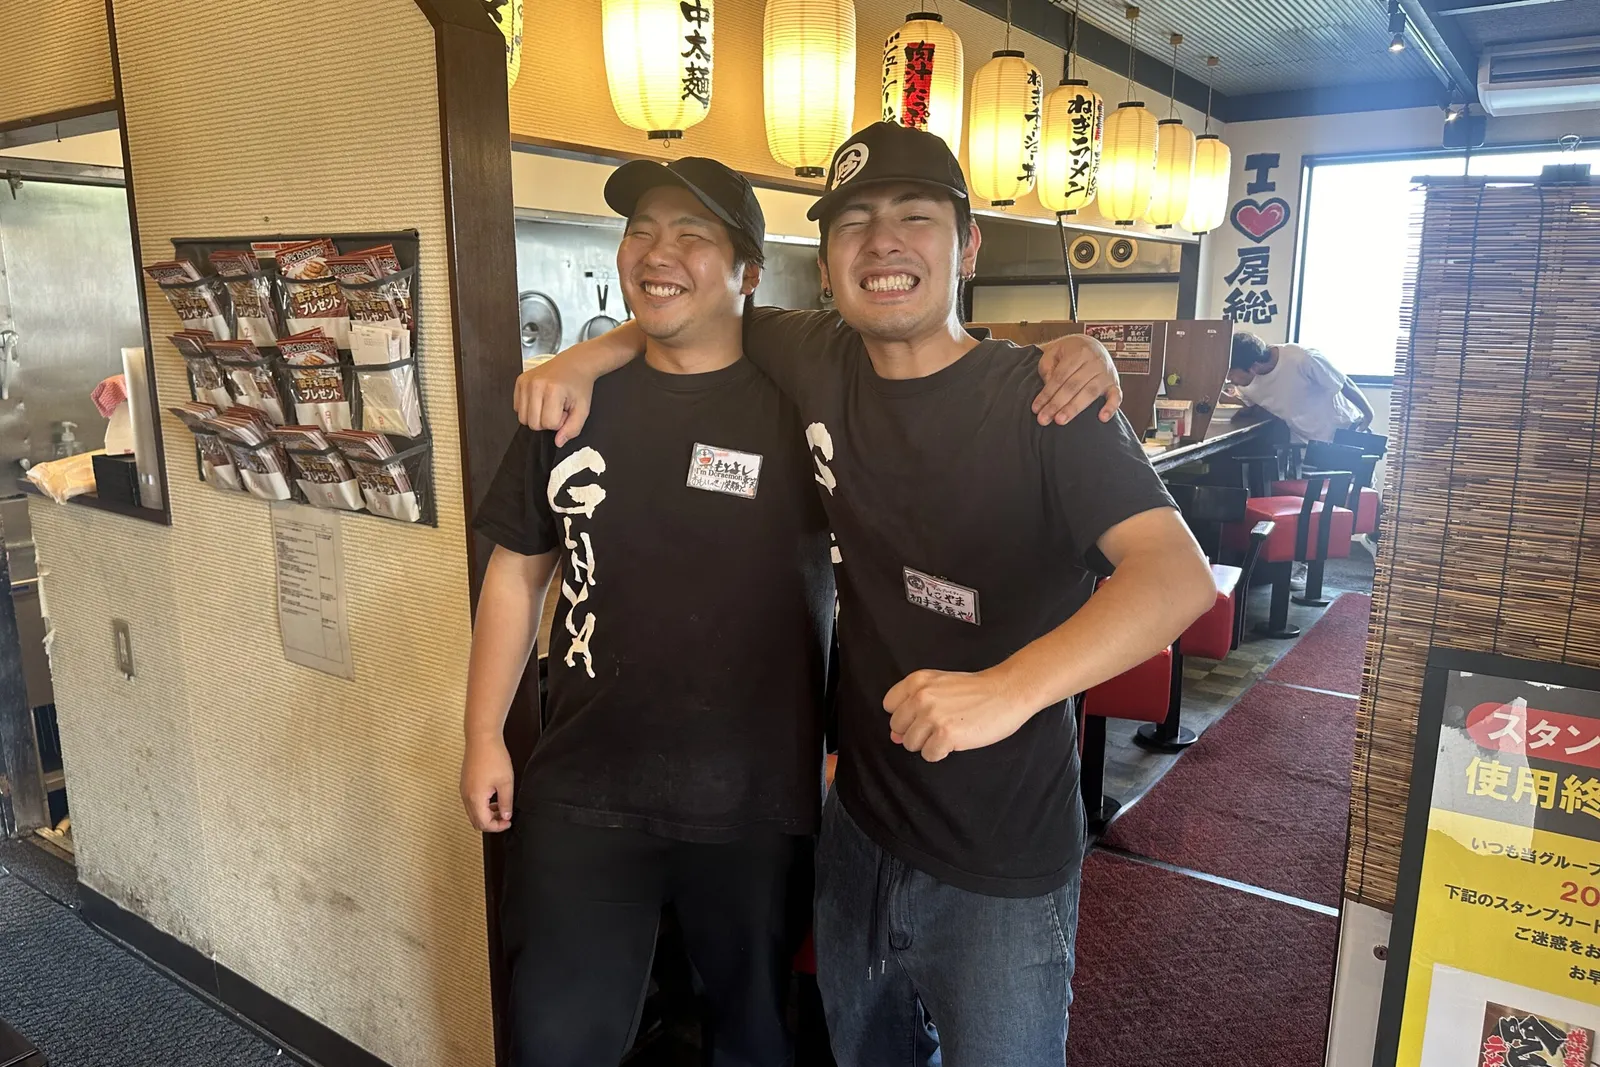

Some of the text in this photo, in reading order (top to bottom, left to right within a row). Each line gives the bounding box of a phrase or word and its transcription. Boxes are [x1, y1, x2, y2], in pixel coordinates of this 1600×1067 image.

[680, 0, 711, 109] 中太麺
[1064, 95, 1093, 198] ねぎラーメン
[300, 296, 341, 315] プレゼント
[1223, 246, 1278, 325] 房総
[302, 388, 341, 400] プレゼント
[1488, 712, 1600, 755] スタン
[1465, 756, 1600, 820] 使用終
[1560, 881, 1600, 907] 20
[1514, 926, 1600, 959] ご迷惑をお
